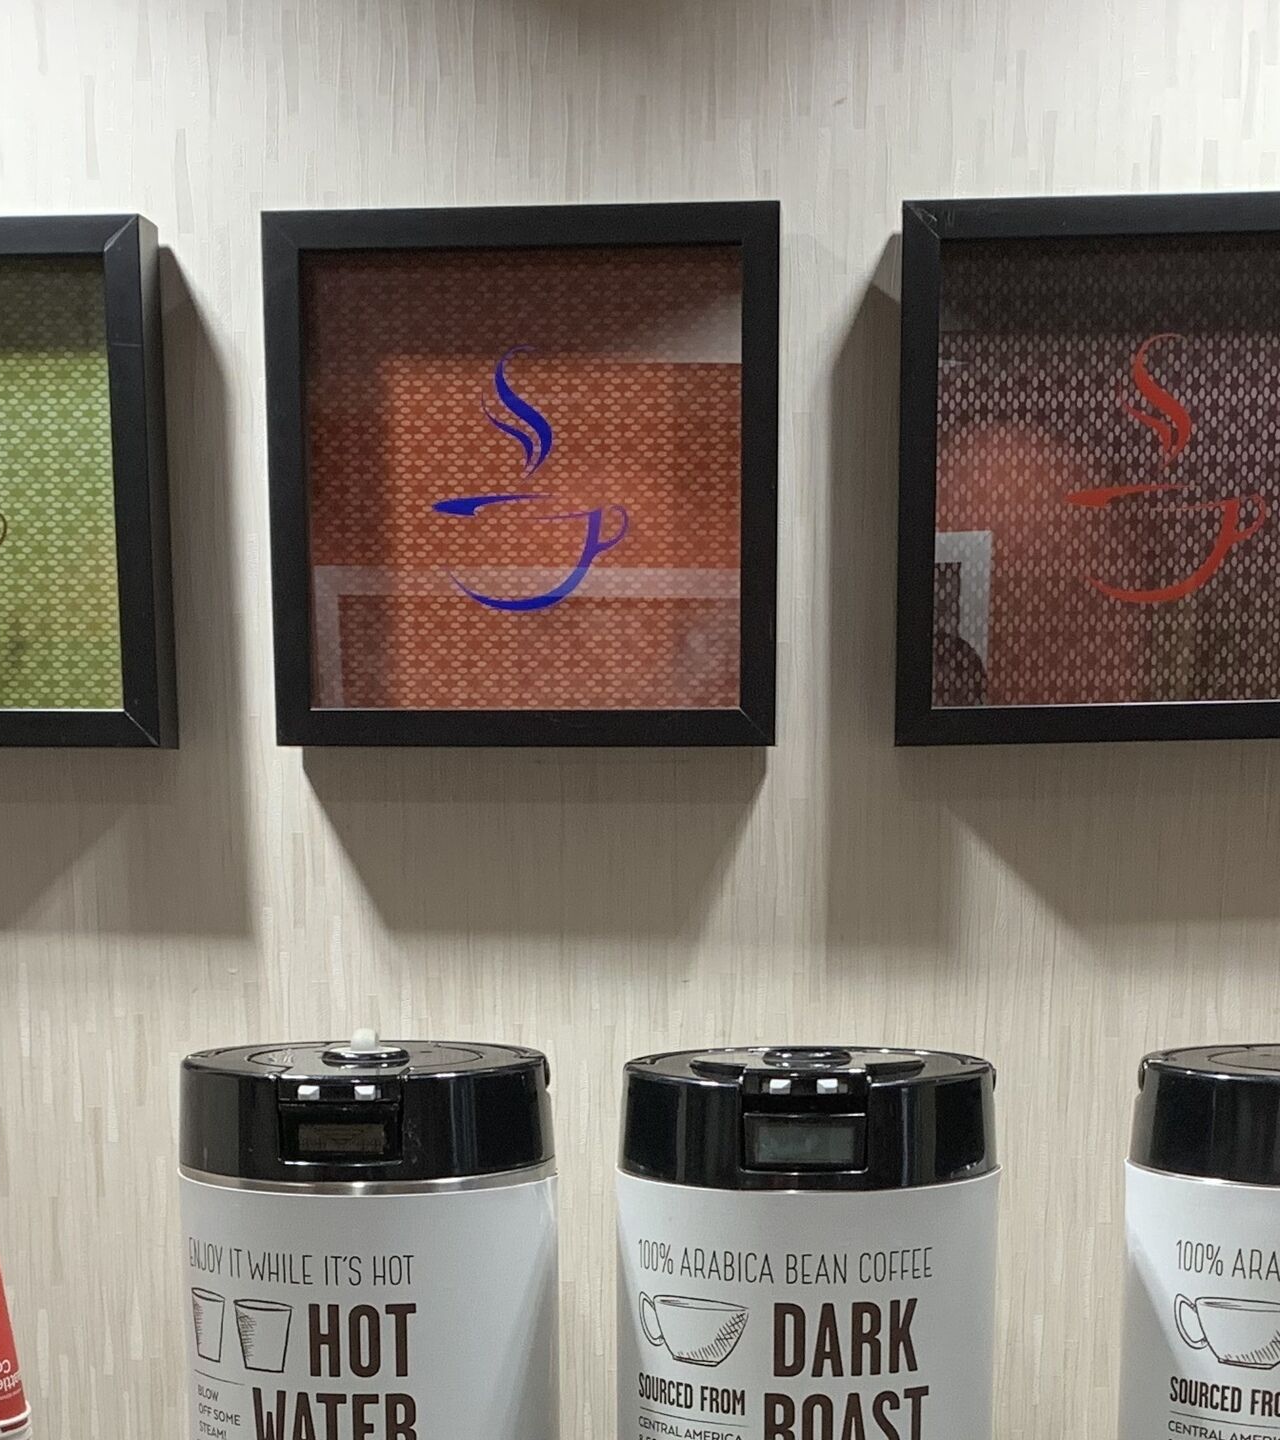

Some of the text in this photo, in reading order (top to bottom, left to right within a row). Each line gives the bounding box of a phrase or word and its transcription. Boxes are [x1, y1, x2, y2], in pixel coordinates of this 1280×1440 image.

[188, 1236, 415, 1287] ENJOY IT WHILE IT'S HOT
[638, 1238, 934, 1285] 100% ARABICA BEAN COFFEE
[1175, 1239, 1224, 1277] 100%
[308, 1302, 418, 1379] HOT
[772, 1297, 919, 1378] DARK
[197, 1383, 219, 1402] BLOW
[638, 1371, 746, 1417] SOURCED FROM
[1169, 1375, 1243, 1414] SOURCED
[198, 1402, 241, 1427] OFF SOME
[199, 1420, 228, 1440] STEAM!
[638, 1414, 682, 1439] CENTRAL
